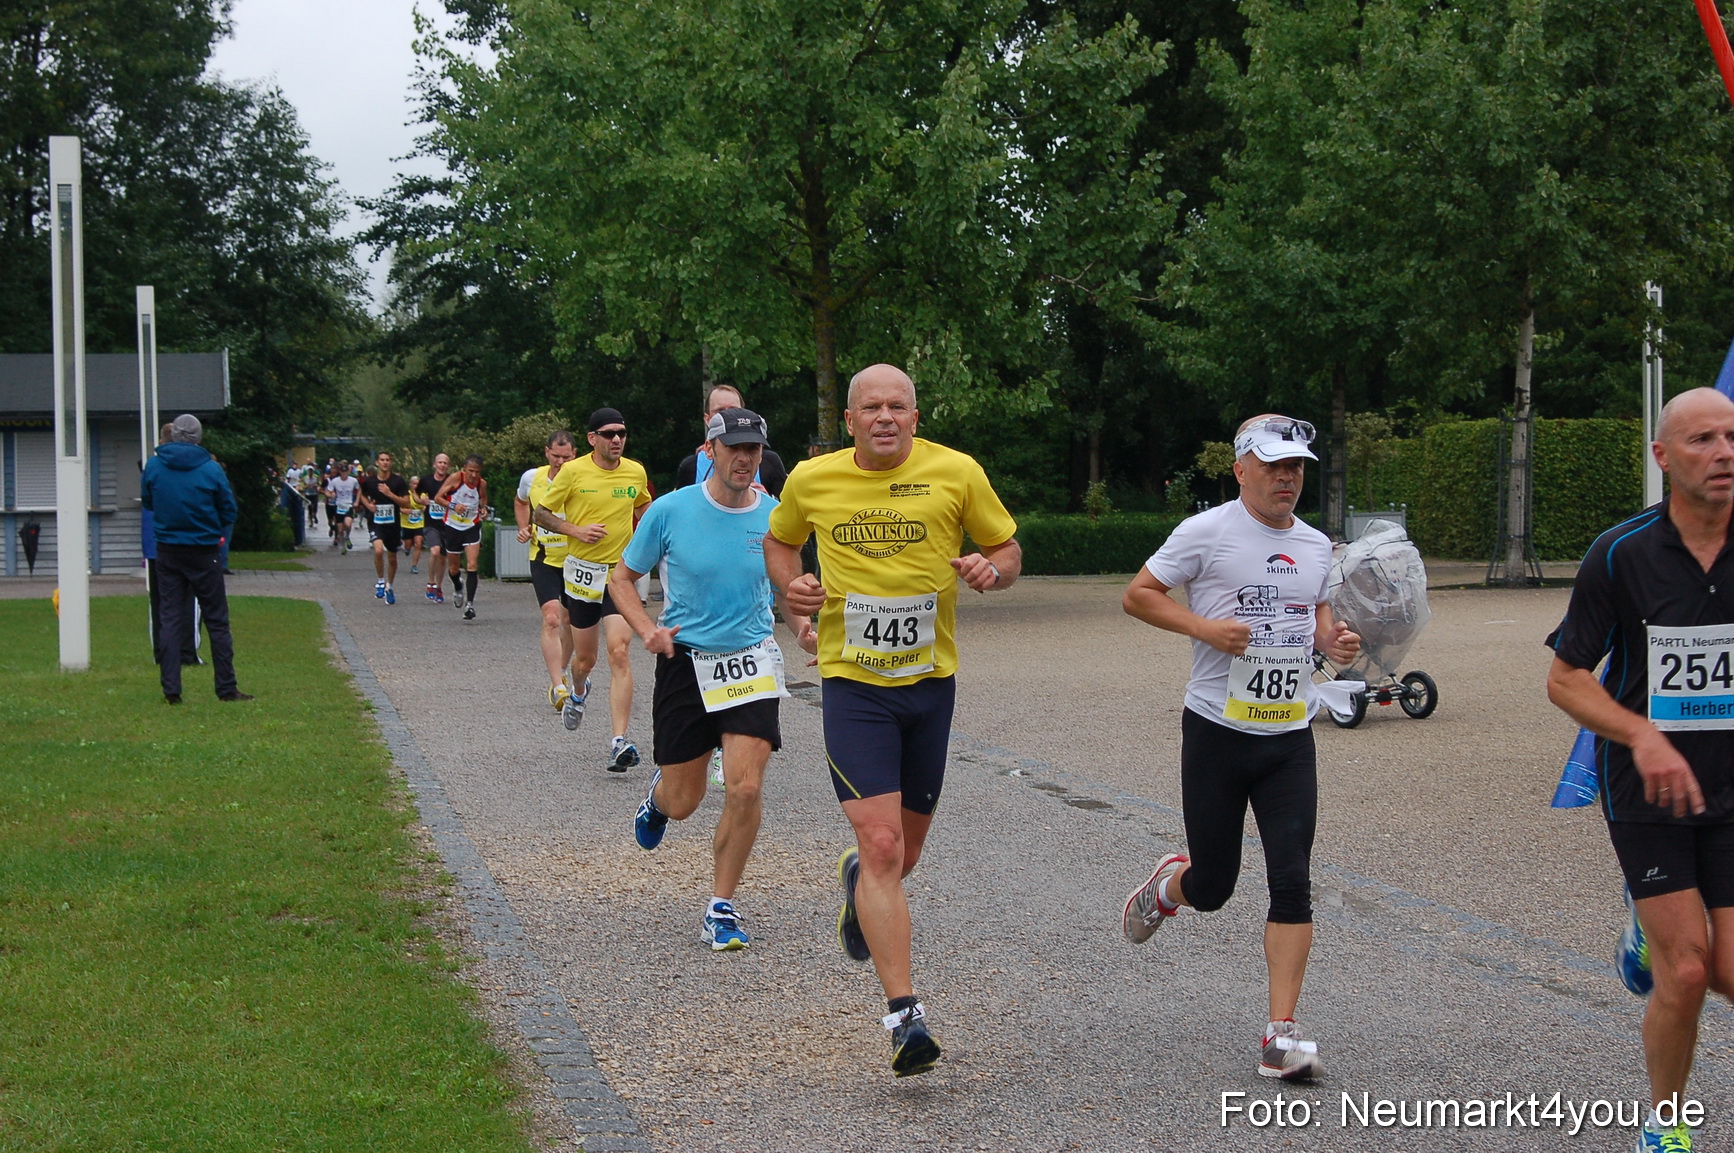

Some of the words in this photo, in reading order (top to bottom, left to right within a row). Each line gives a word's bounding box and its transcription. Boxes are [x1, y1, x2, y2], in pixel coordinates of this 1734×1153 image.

[852, 509, 904, 524] PIZZERIA
[841, 524, 915, 542] FRANCESCO
[574, 568, 593, 586] 99
[1266, 565, 1299, 575] skinfit
[846, 601, 876, 613] PARTL
[878, 603, 922, 614] Neumarkt
[863, 616, 919, 647] 443
[1650, 636, 1689, 647] PARTL
[719, 645, 753, 659] Neumarkt
[855, 651, 921, 667] Hans-Peter
[1234, 653, 1263, 665] PARTL
[1265, 656, 1303, 664] Neumarkt
[713, 654, 758, 683] 466
[1660, 651, 1734, 691] 254
[727, 684, 755, 698] Claus
[1246, 668, 1300, 700] 485
[1247, 706, 1292, 720] Thomas
